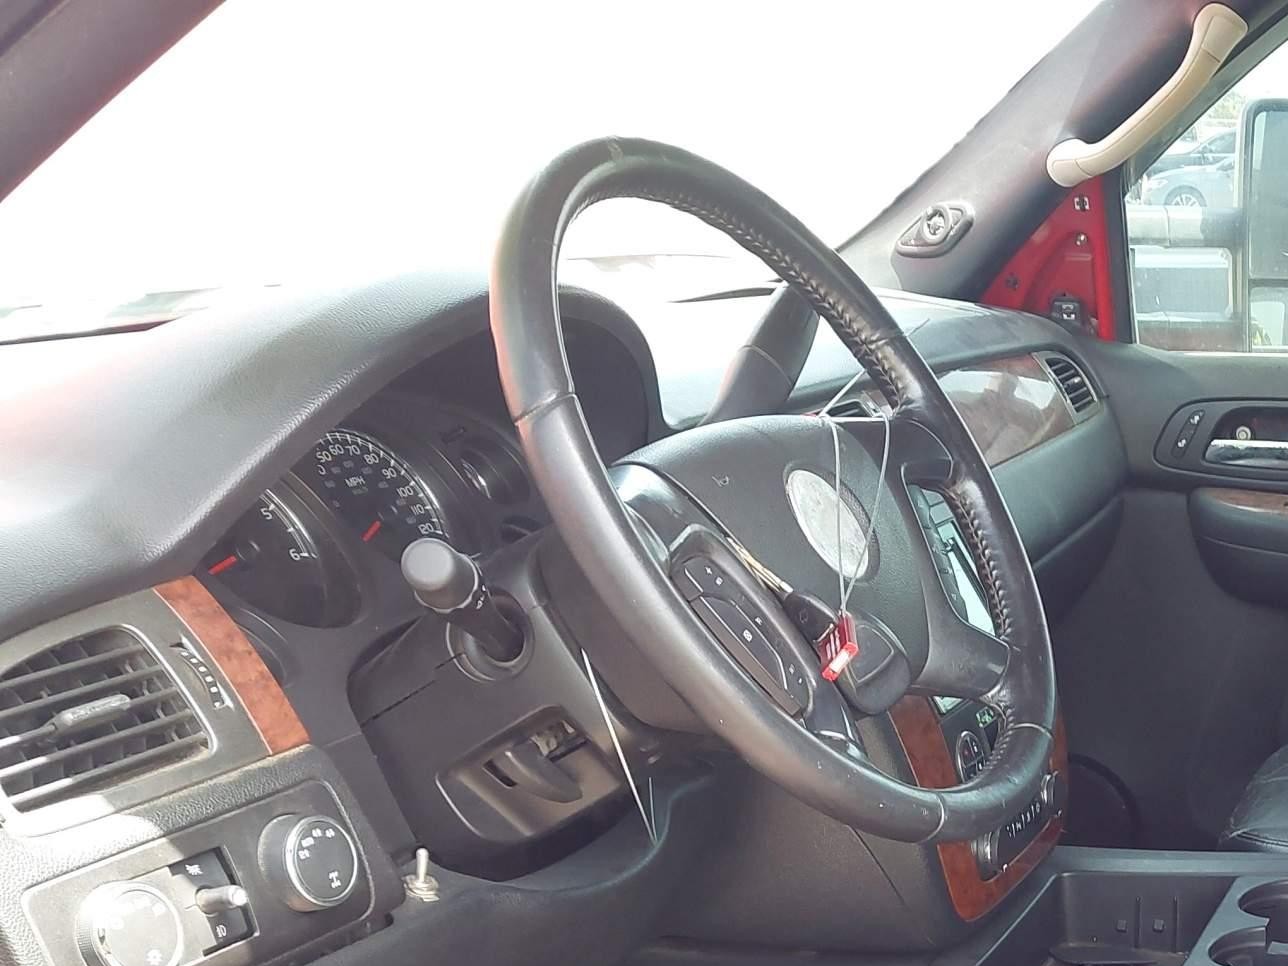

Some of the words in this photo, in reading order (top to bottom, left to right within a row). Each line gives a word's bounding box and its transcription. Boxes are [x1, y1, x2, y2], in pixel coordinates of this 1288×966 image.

[329, 444, 345, 456] 60
[345, 445, 361, 456] 70
[316, 451, 332, 463] 50
[364, 453, 379, 465] 80
[382, 467, 397, 479] 90
[345, 476, 366, 488] MPH
[397, 486, 414, 498] 100
[260, 508, 273, 520] 5
[411, 504, 425, 515] 110
[418, 523, 434, 535] 120
[289, 548, 301, 561] 6
